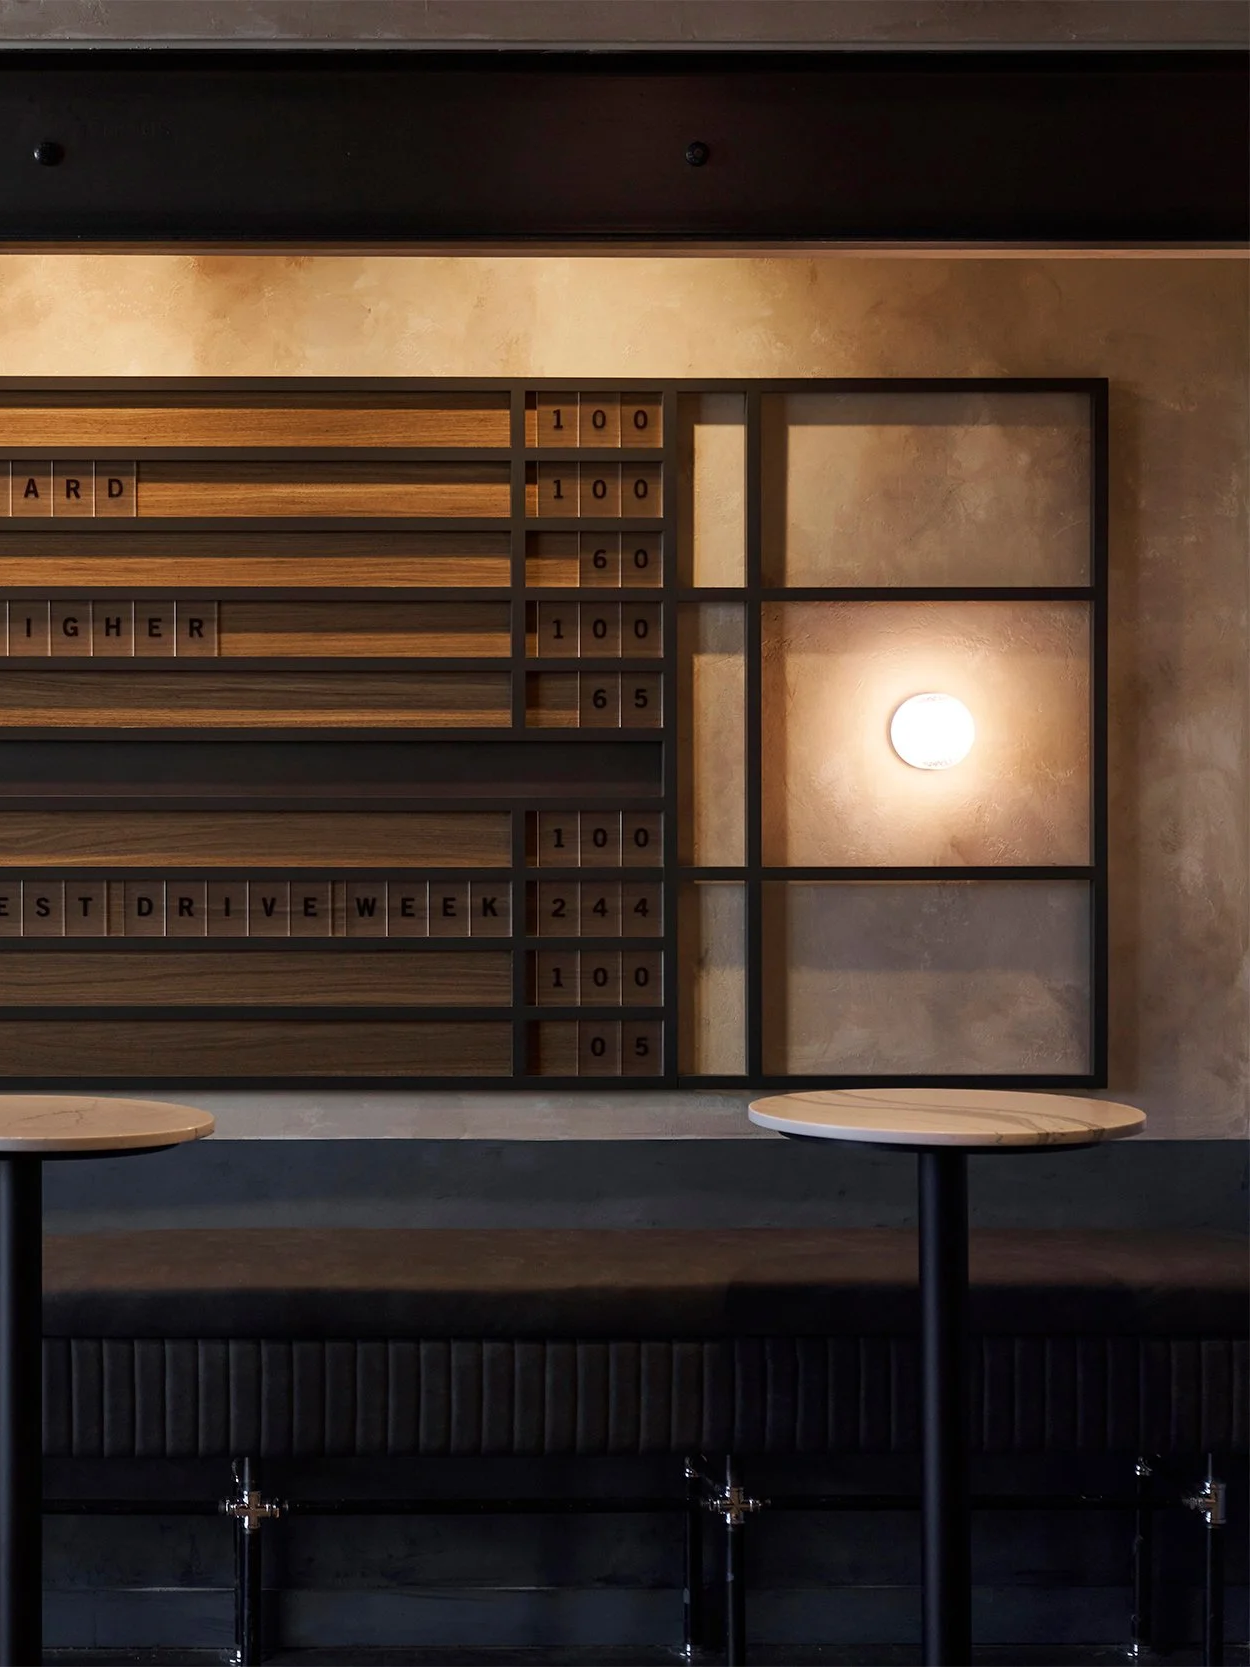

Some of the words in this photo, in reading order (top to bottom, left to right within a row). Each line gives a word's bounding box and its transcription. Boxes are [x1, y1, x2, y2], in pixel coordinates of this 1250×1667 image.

[552, 408, 648, 430] 100
[552, 478, 648, 500] 100
[593, 549, 648, 570] 60
[552, 618, 648, 639] 100
[593, 688, 648, 709] 65
[552, 827, 648, 849] 100
[138, 896, 317, 918] DRIVE
[356, 896, 499, 918] WEEK
[552, 896, 648, 918] 244
[552, 966, 648, 988] 100
[591, 1036, 649, 1058] 05
